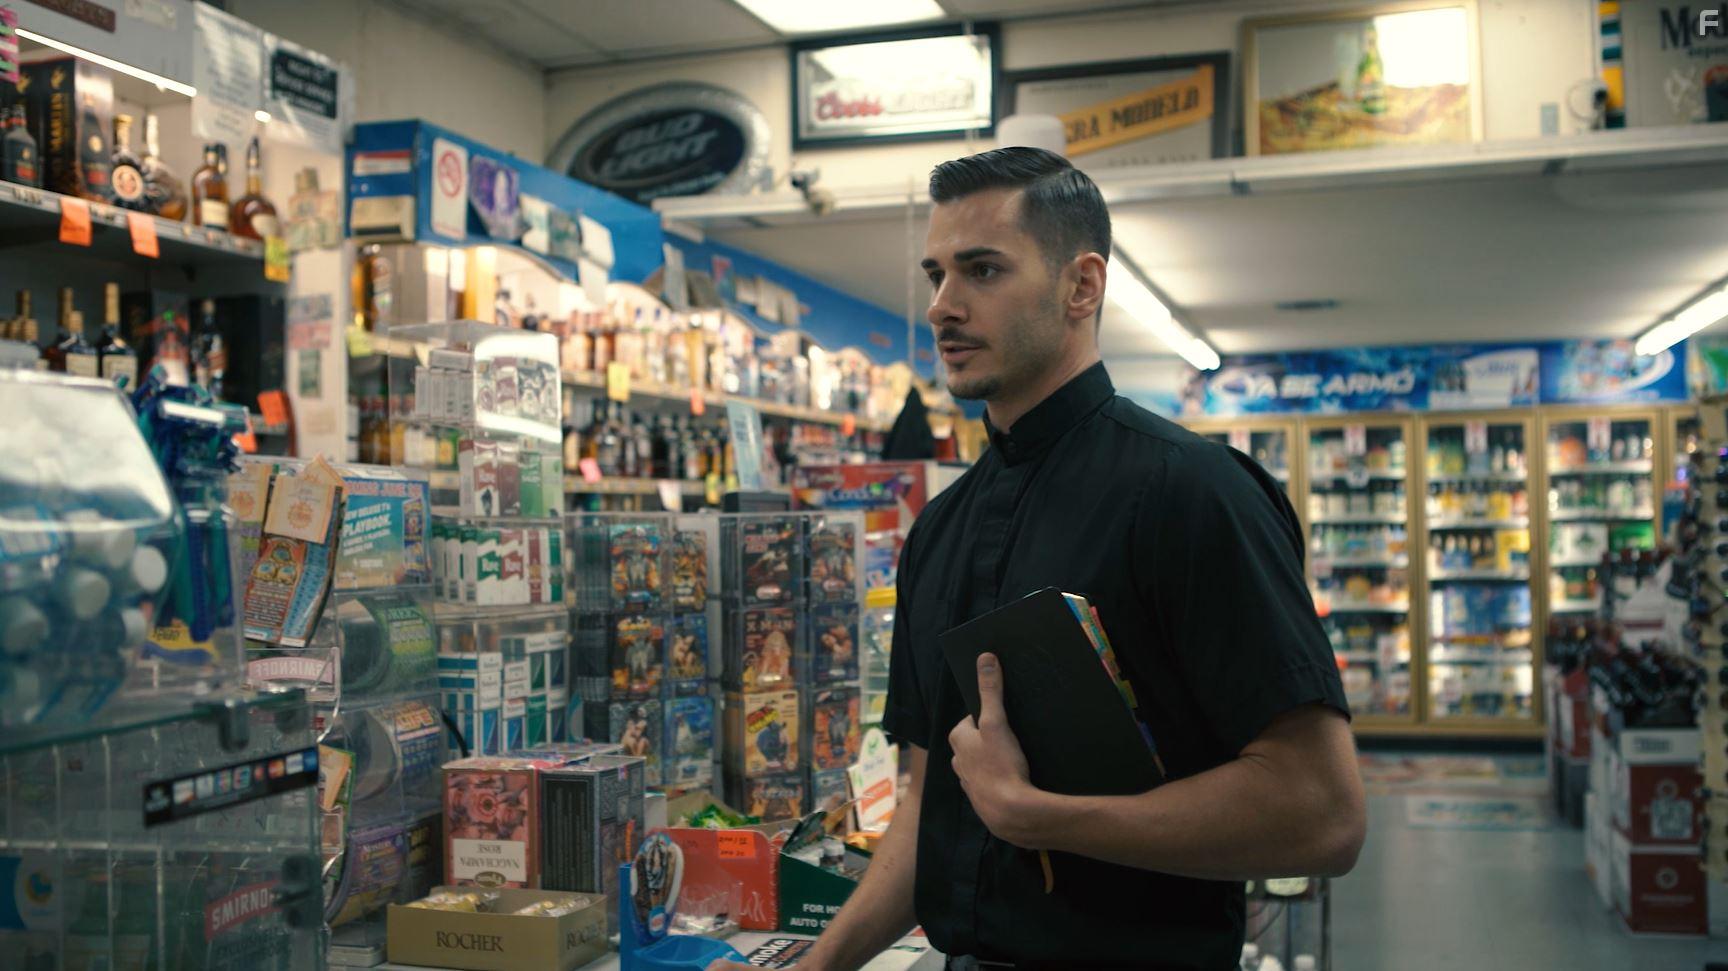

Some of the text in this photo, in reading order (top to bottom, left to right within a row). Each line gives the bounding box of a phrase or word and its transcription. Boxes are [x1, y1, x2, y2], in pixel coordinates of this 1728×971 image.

[612, 112, 706, 153] BUD
[601, 127, 720, 179] LIGHT
[212, 887, 283, 932] SMIRNO
[789, 917, 818, 929] AUTO
[802, 903, 842, 915] FOR HO
[435, 930, 504, 952] ROCHER
[748, 939, 794, 967] moke
